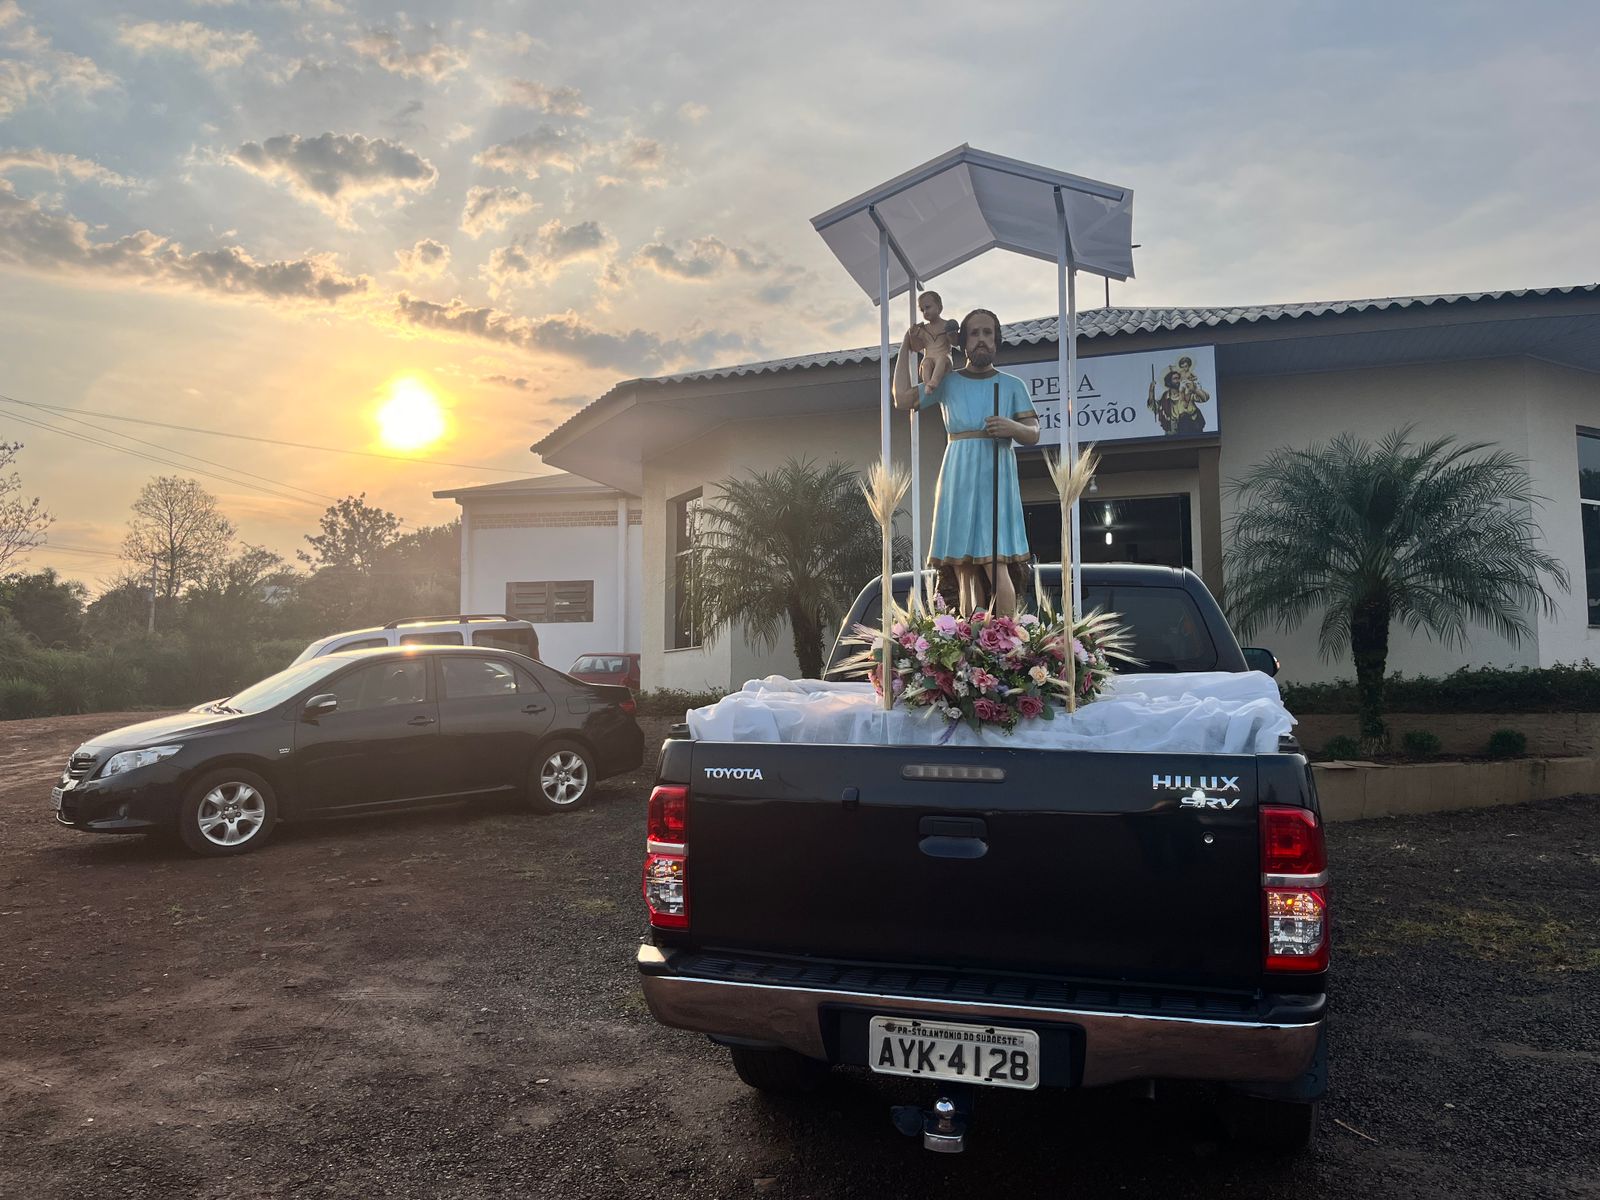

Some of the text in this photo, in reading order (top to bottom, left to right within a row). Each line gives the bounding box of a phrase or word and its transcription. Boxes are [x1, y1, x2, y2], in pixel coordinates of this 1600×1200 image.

[704, 767, 763, 780] TOYOTA
[1152, 774, 1240, 792] HILUX
[1180, 796, 1240, 810] SRV
[963, 1032, 974, 1041] DO
[975, 1033, 1018, 1046] SUDOESTE
